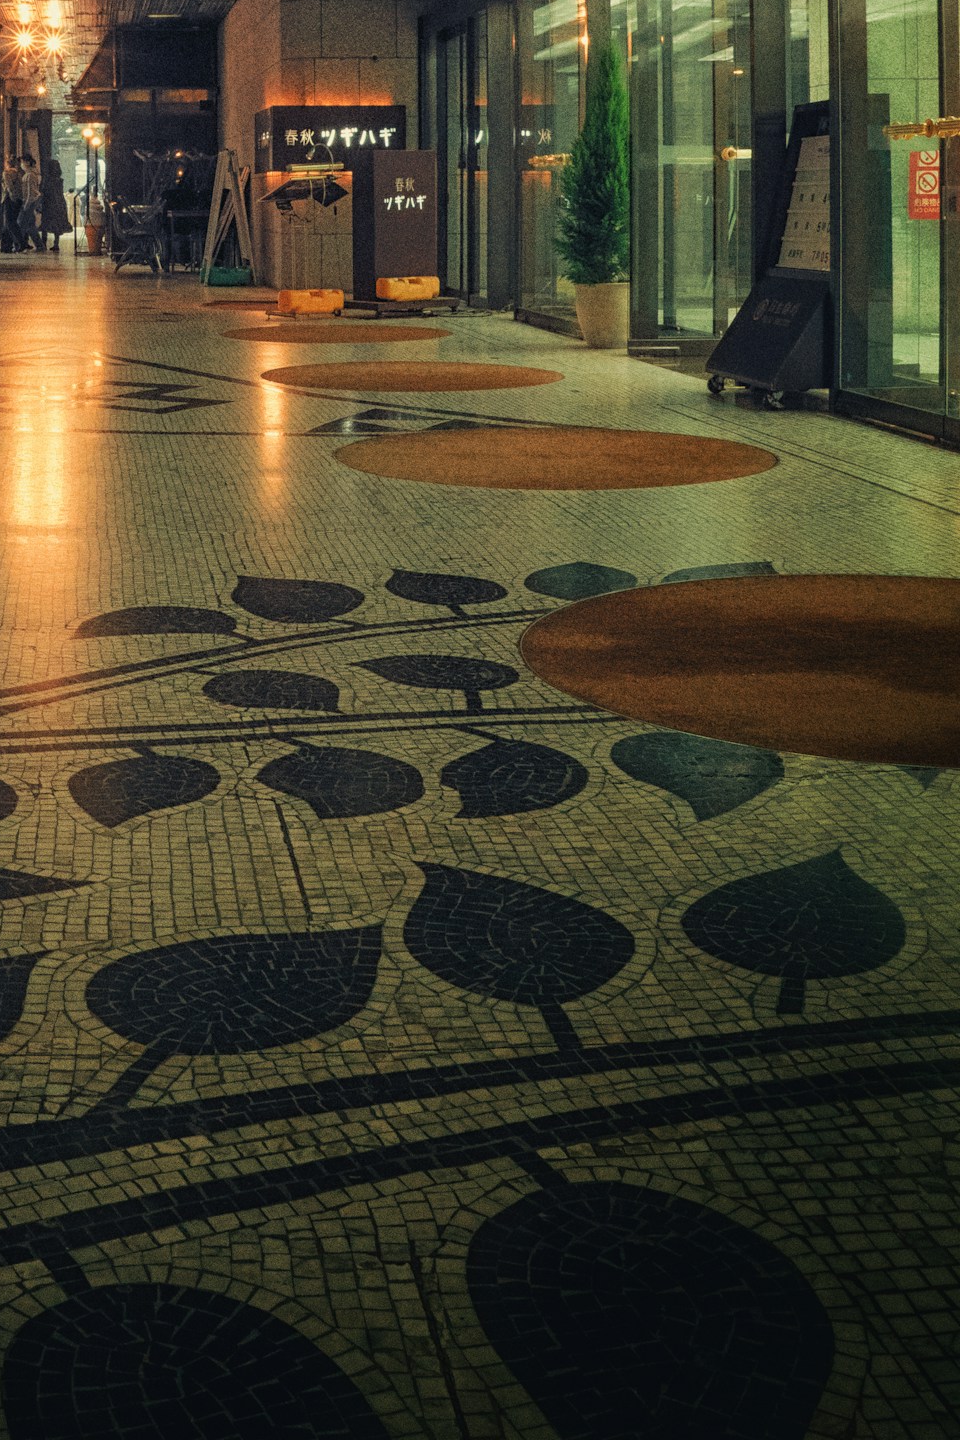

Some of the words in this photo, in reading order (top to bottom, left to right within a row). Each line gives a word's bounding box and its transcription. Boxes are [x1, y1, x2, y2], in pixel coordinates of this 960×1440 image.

[284, 128, 315, 146] 春秋
[321, 127, 396, 147] ツギハギ
[395, 177, 415, 192] 春秋
[383, 195, 427, 210] ツギハギ
